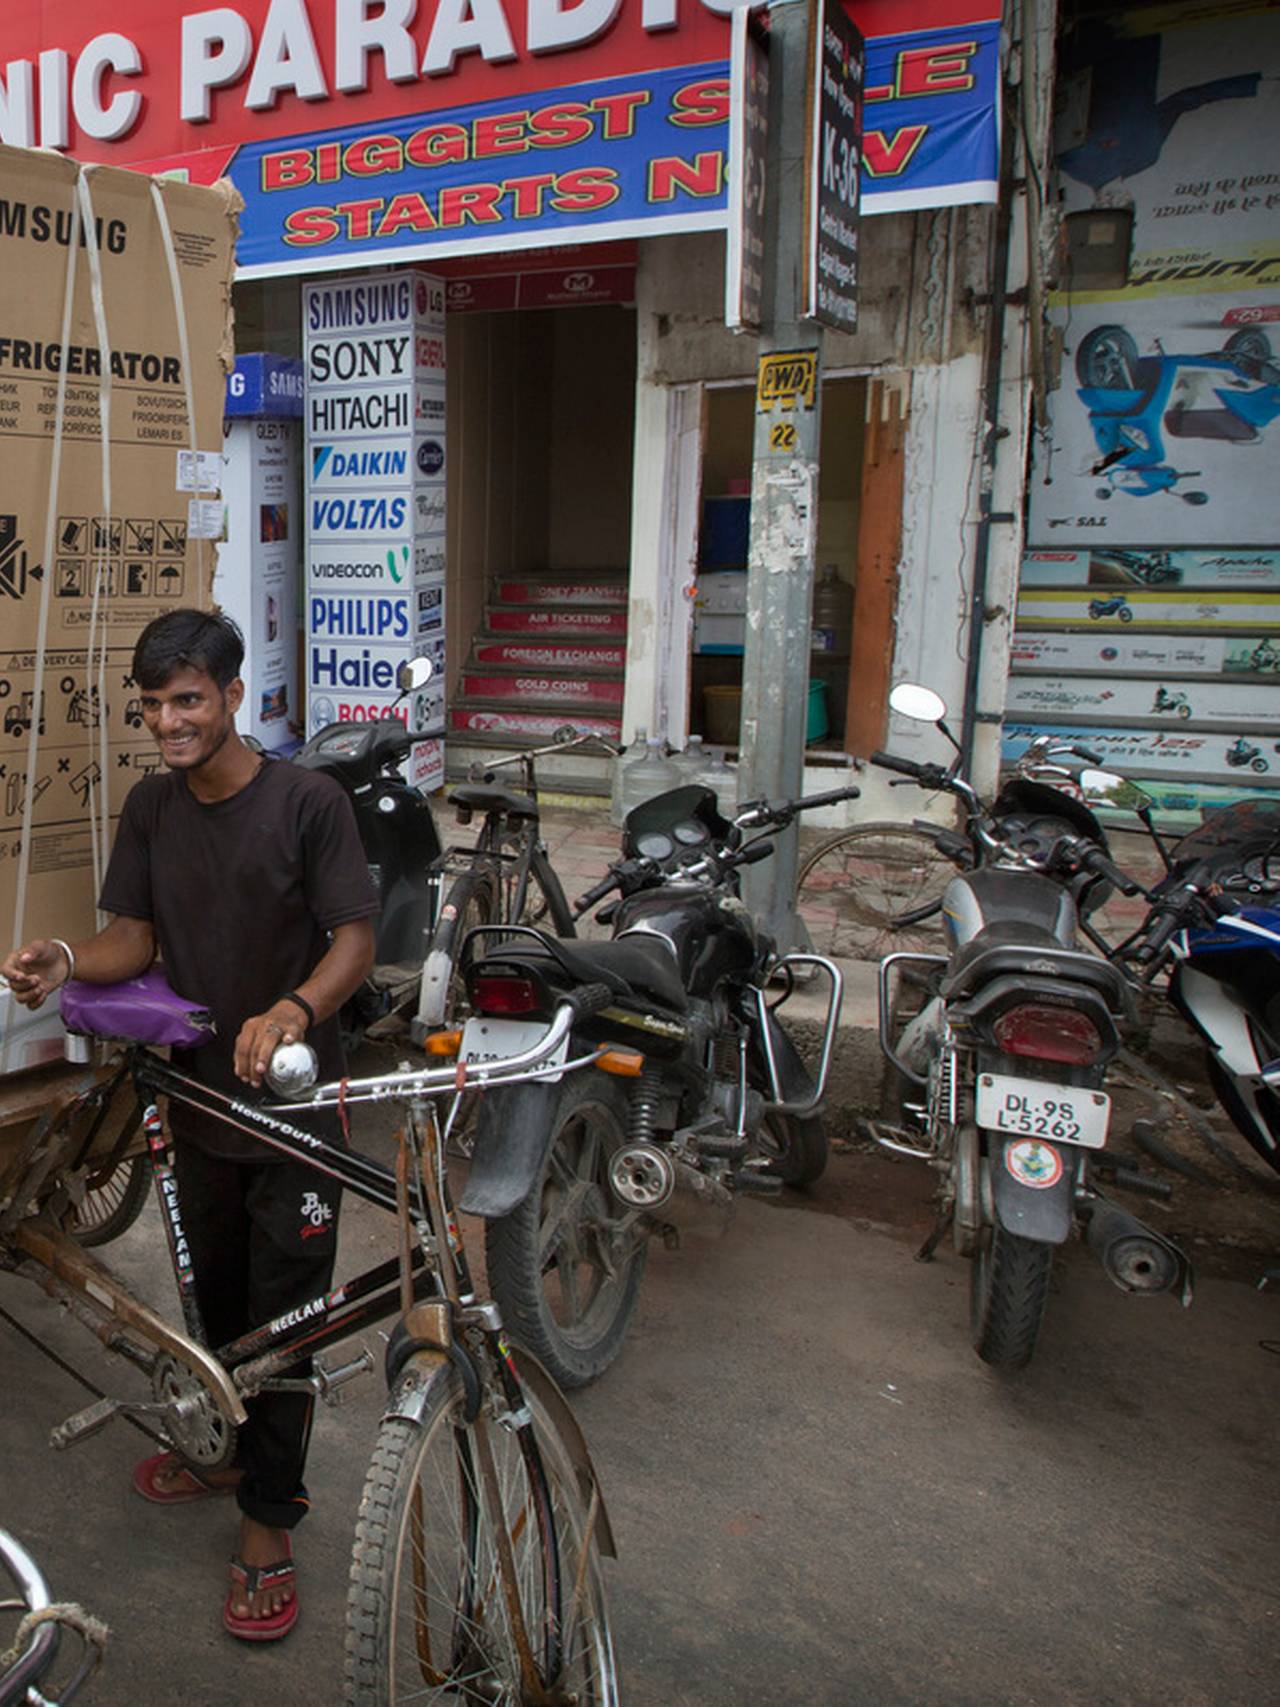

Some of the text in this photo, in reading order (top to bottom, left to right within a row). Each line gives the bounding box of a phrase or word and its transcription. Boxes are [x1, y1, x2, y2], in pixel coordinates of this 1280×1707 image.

[180, 0, 740, 122] PARAD
[261, 91, 650, 191] BIGGEST
[670, 41, 978, 127] SE
[824, 120, 858, 208] K-36
[282, 124, 928, 246] STARTS NW
[309, 281, 411, 332] SAMSUNG
[310, 338, 410, 383] SONY
[270, 373, 304, 398] SAMS
[312, 394, 409, 433] HITACHI
[772, 425, 796, 447] 22
[331, 450, 407, 478] DAIKIN
[312, 497, 406, 532] VOLTAS
[65, 569, 77, 589] 2
[536, 585, 570, 598] ONEY
[312, 598, 409, 637] PHILIPS
[528, 613, 612, 625] AIR TICKETING
[554, 650, 621, 662] EXCHANGE
[515, 679, 590, 692] GOLD COINS
[338, 702, 408, 730] BOSCH
